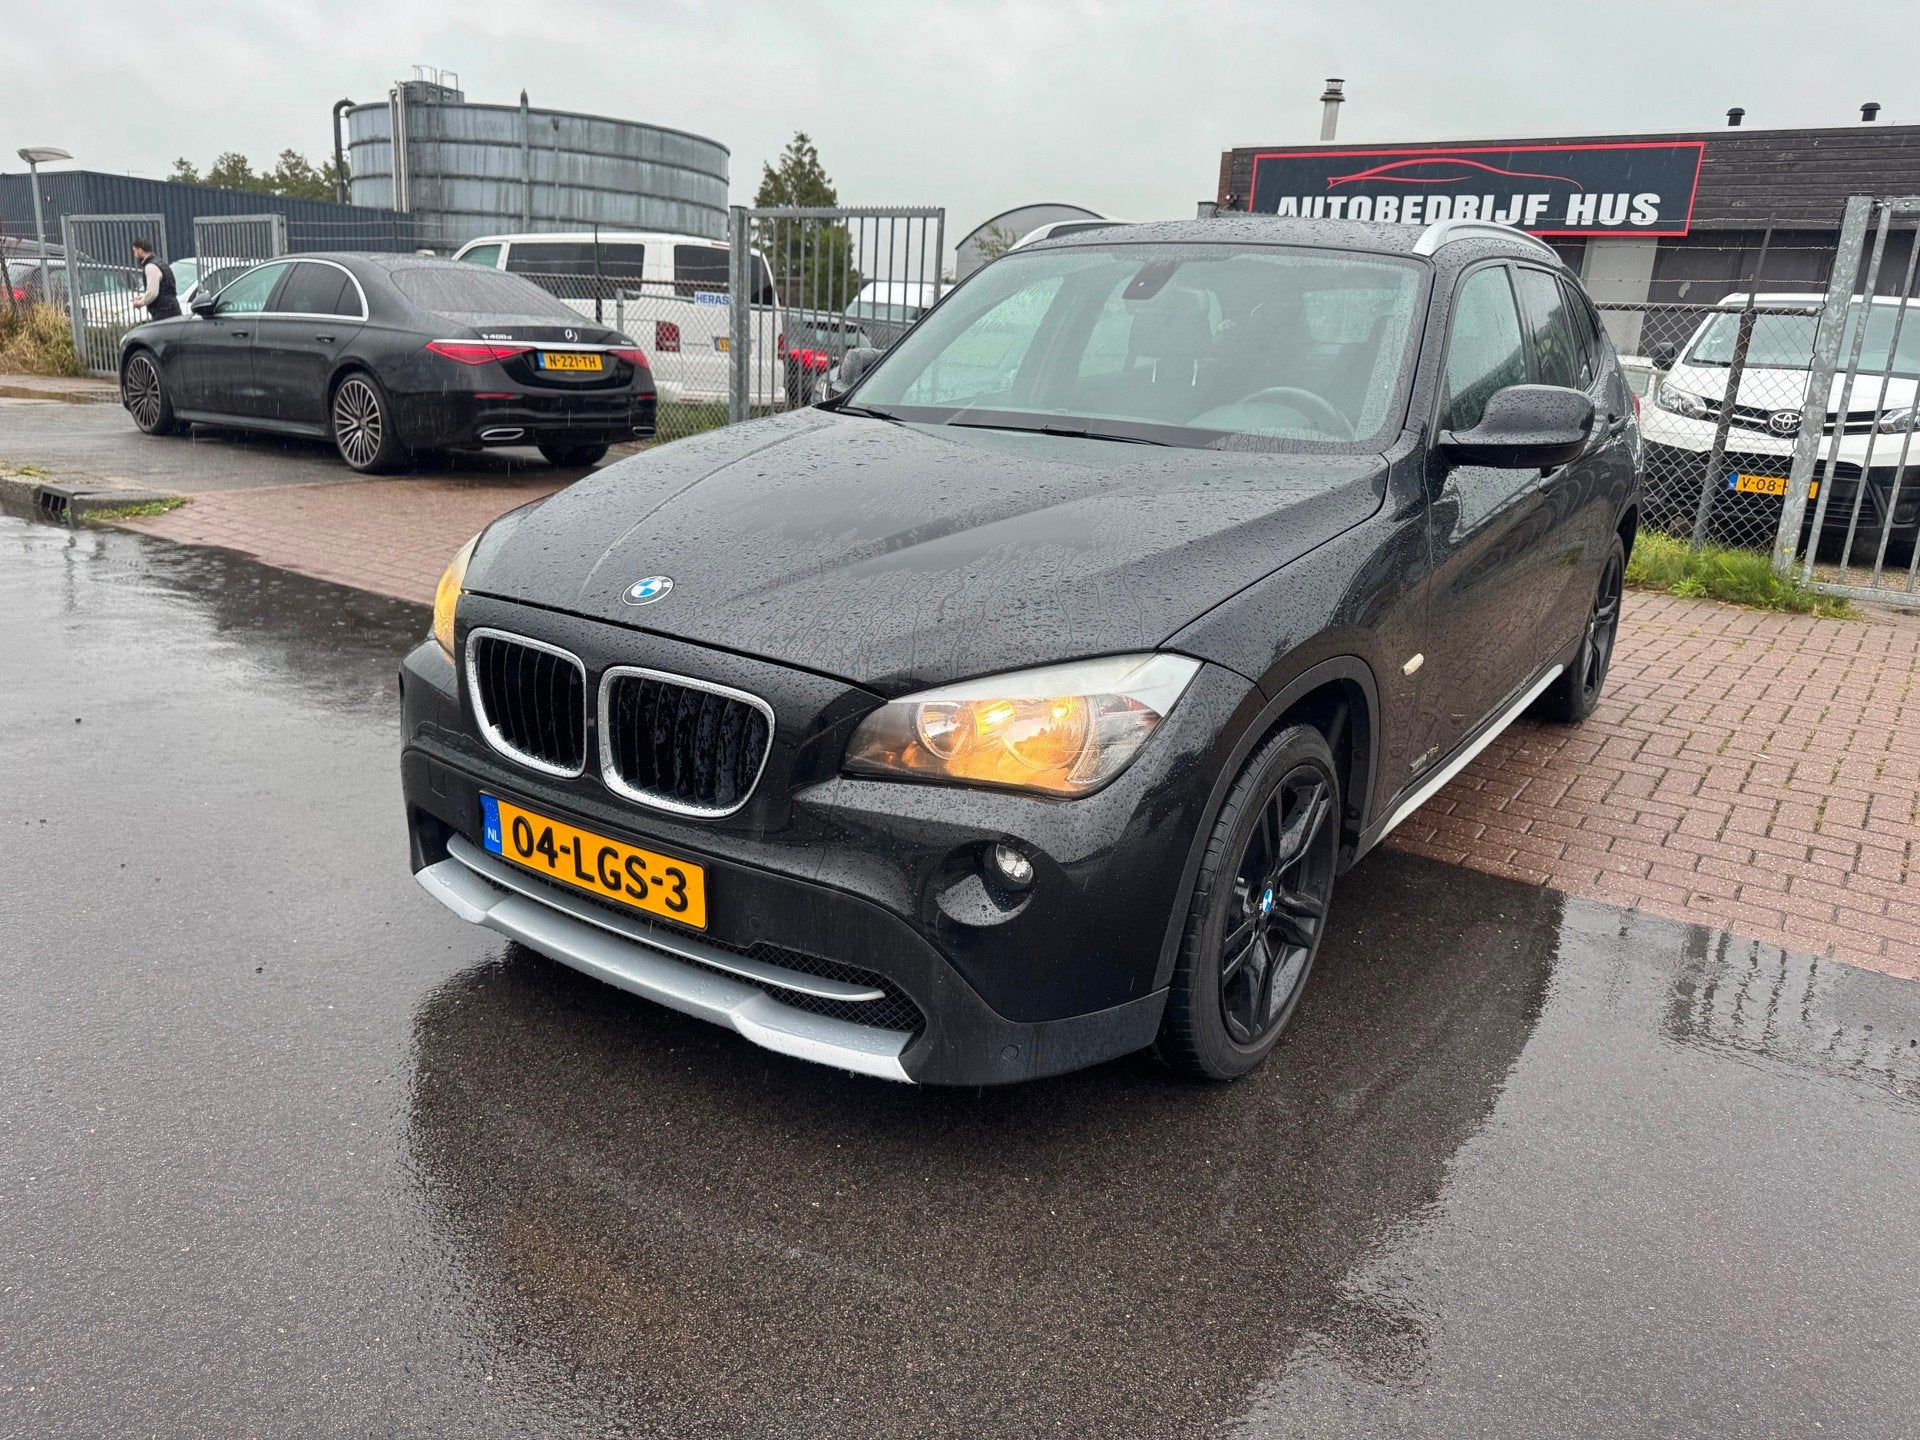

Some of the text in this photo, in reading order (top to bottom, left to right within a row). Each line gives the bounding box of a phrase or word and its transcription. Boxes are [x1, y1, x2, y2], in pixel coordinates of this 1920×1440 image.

[1277, 193, 1661, 226] AUTOBEDRIJF HUS
[696, 294, 730, 305] HERAS
[487, 827, 500, 843] NL
[512, 815, 689, 913] 04-LGS-3
